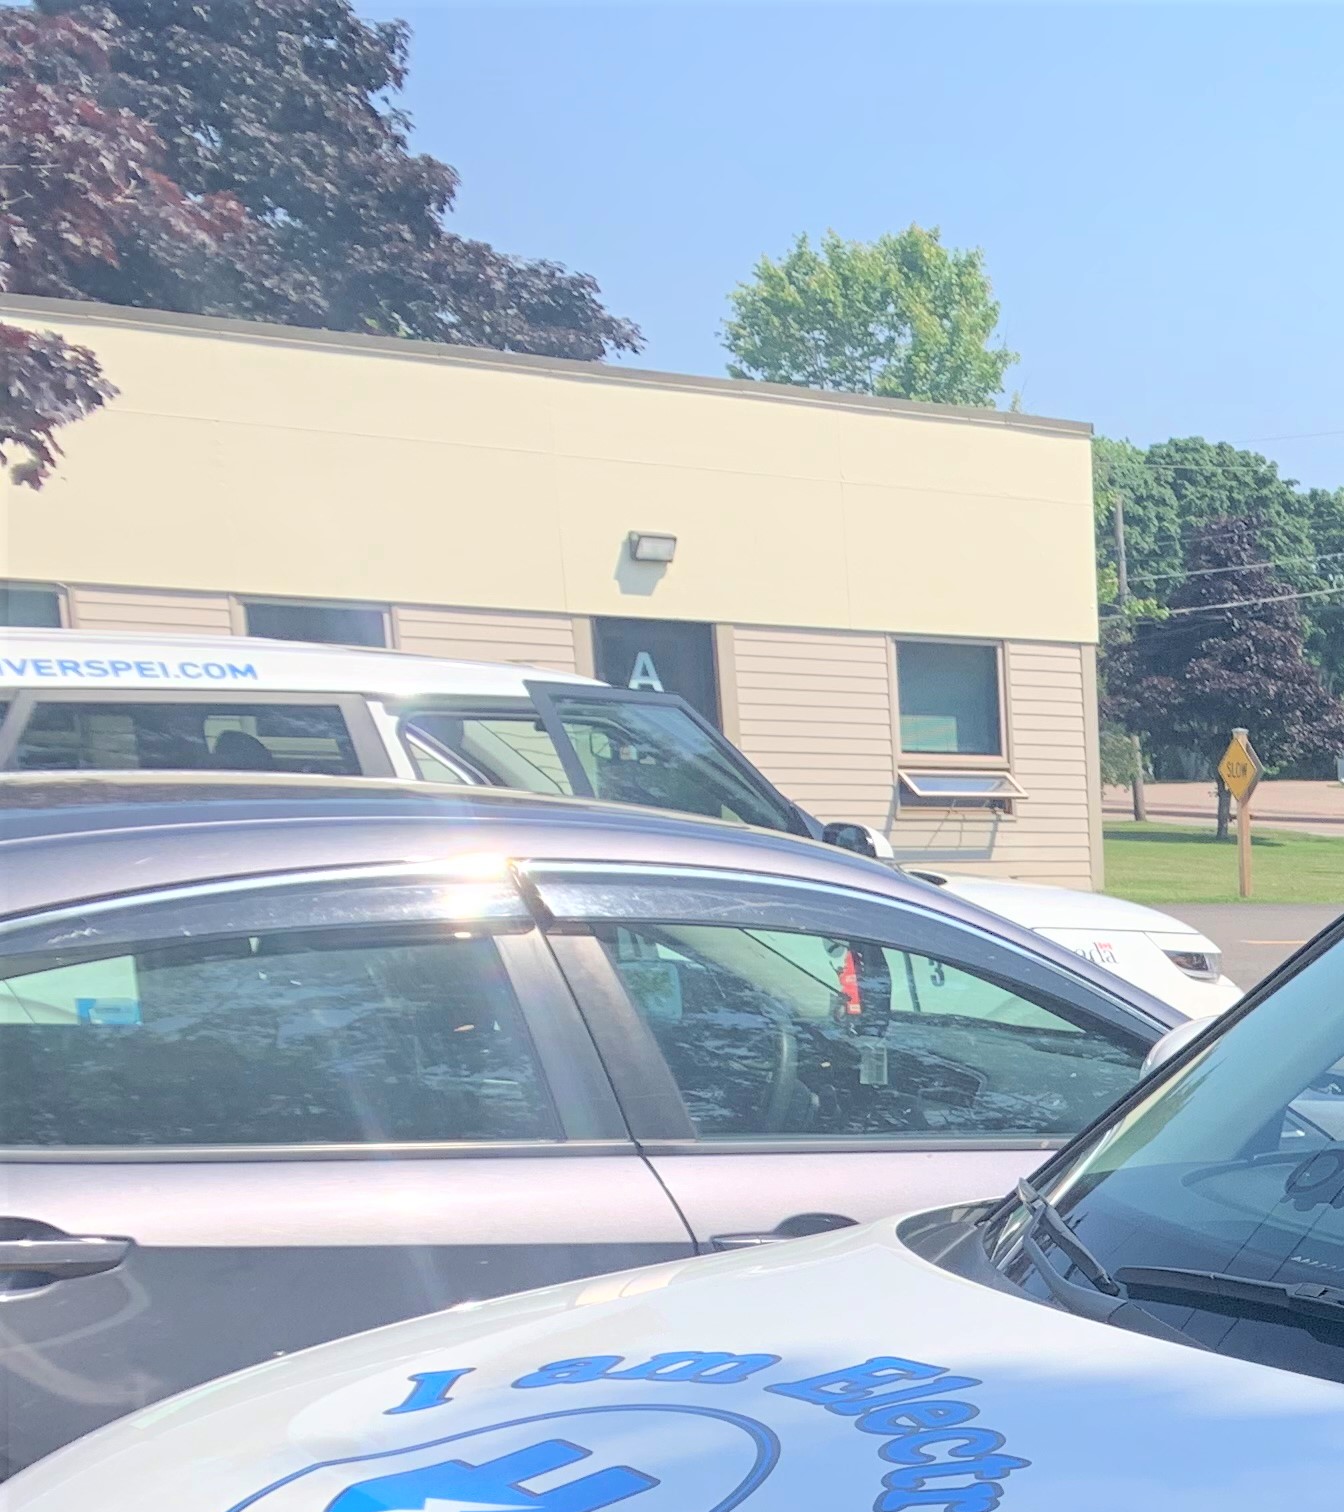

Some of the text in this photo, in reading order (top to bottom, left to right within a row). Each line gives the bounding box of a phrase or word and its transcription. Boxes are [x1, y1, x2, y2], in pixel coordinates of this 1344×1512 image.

[628, 651, 665, 693] A
[1226, 761, 1248, 779] SLOW
[929, 959, 945, 988] 3
[510, 1350, 783, 1390] am
